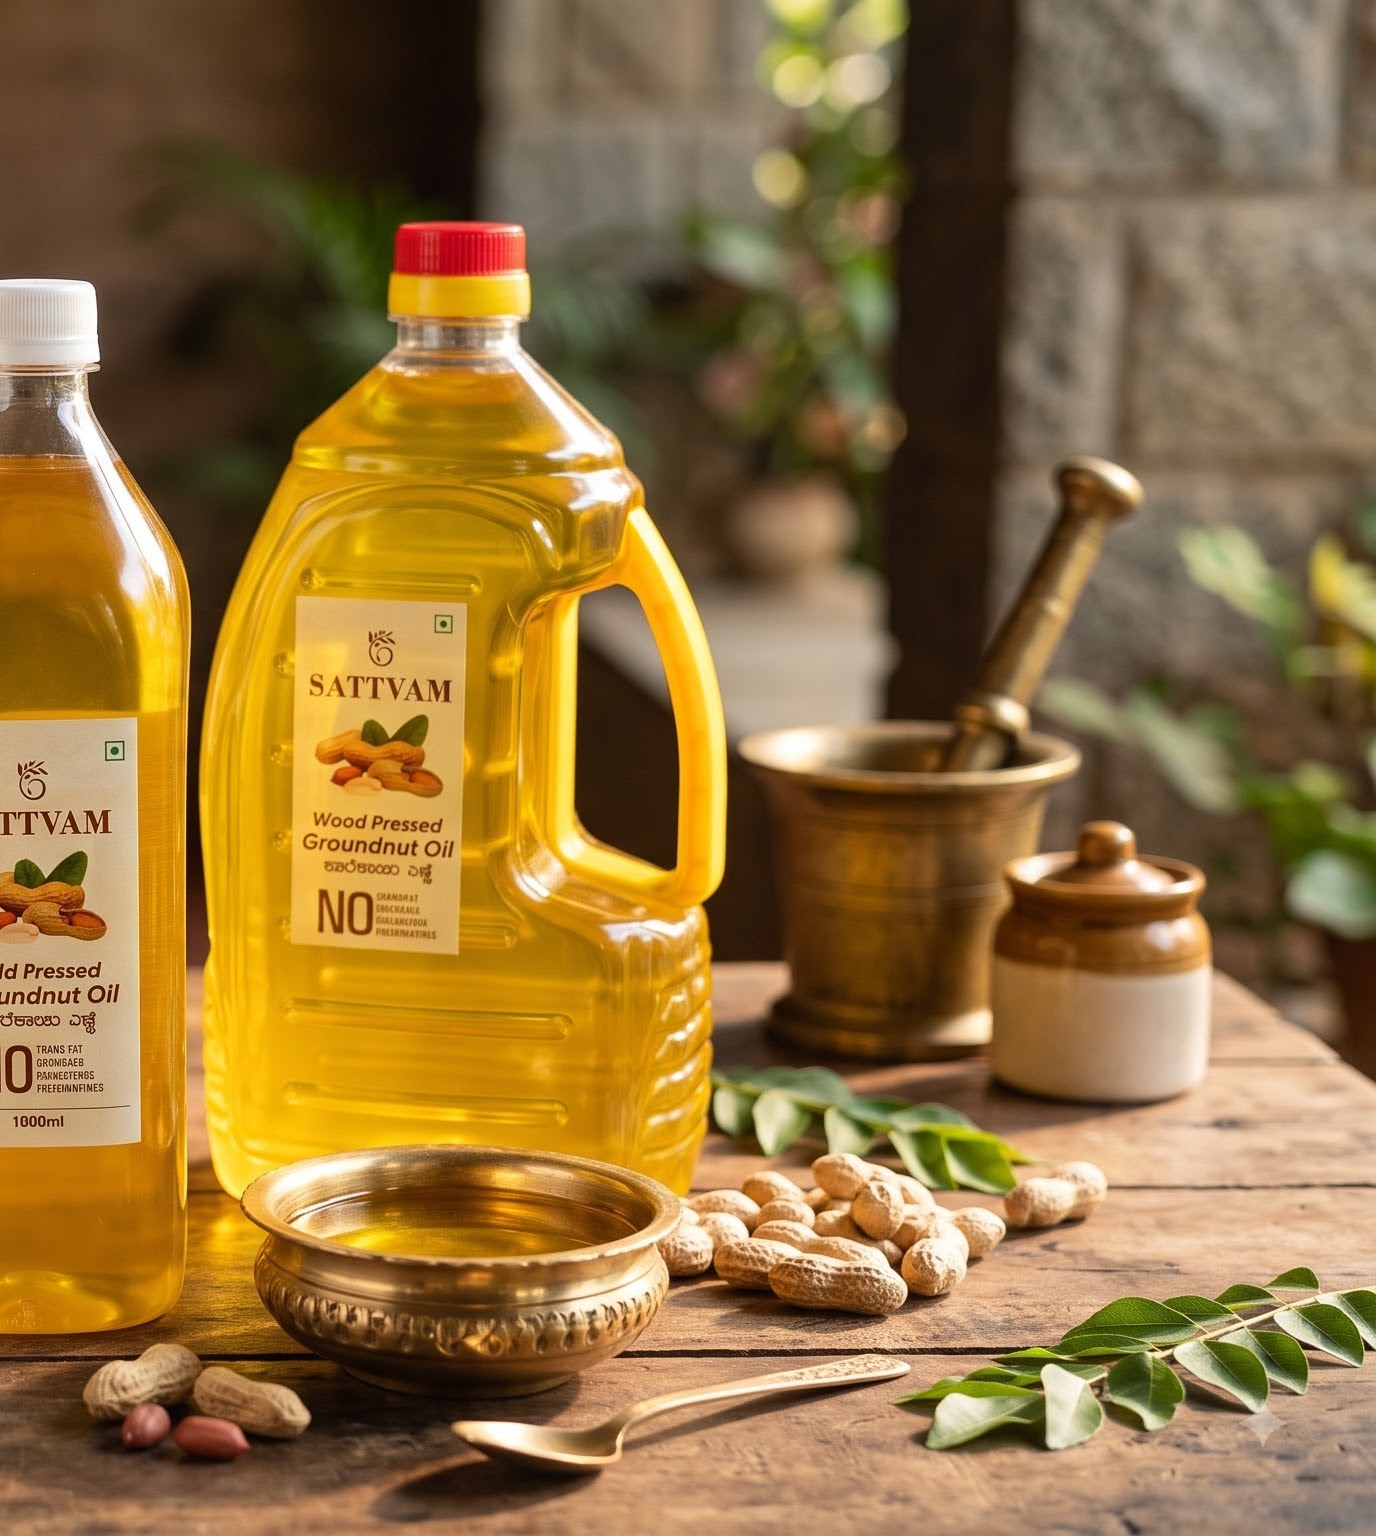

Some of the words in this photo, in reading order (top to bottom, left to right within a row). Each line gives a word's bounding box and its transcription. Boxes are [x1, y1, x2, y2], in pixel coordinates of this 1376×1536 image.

[309, 673, 453, 704] SATTVAM
[312, 811, 368, 830] Wood
[371, 815, 444, 834] Pressed
[302, 833, 419, 857] Groundnut
[423, 840, 455, 859] Oil
[317, 888, 374, 936] NO
[22, 961, 102, 980] Pressed
[87, 983, 120, 1004] Oil
[36, 1044, 66, 1055] TRANS
[67, 1044, 84, 1054] FAT
